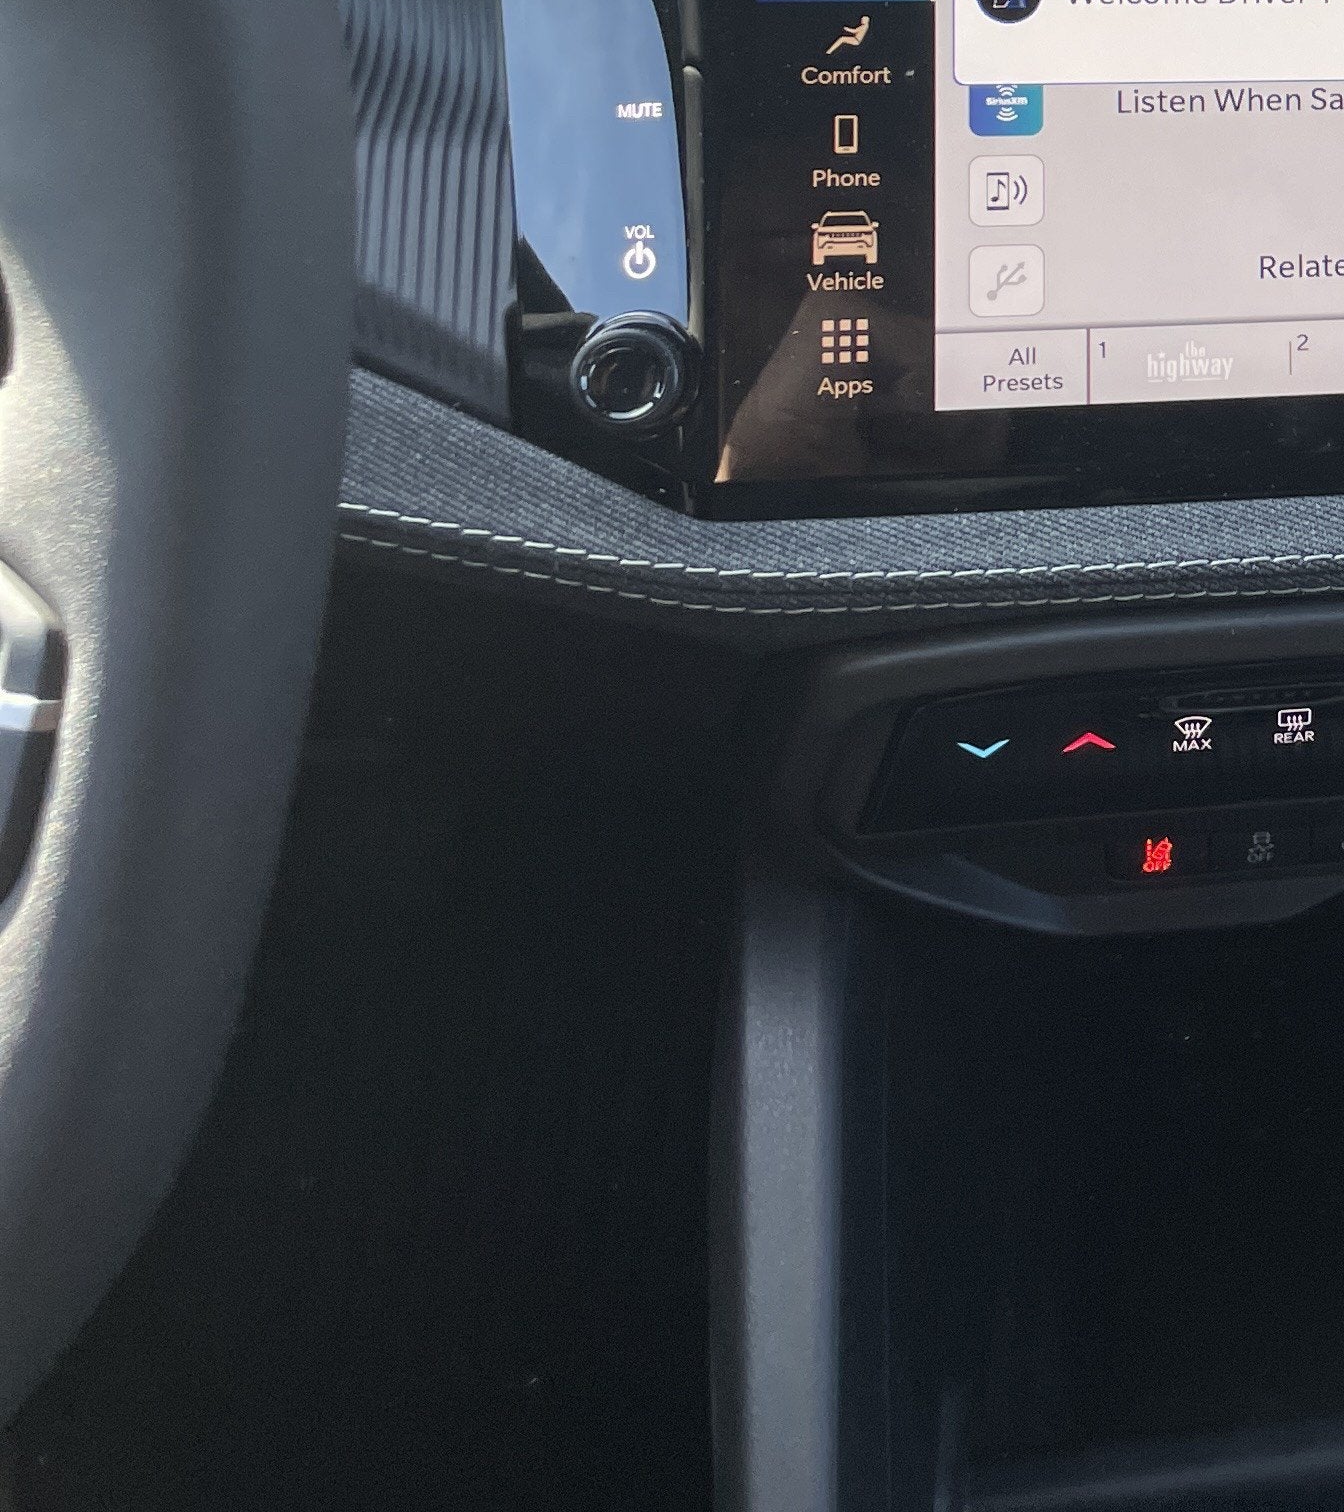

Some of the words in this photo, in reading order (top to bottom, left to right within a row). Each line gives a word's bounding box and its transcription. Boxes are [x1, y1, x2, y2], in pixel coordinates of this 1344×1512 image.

[801, 65, 891, 85] Comfort
[617, 102, 663, 118] MUTE
[1116, 88, 1206, 115] Listen
[1214, 87, 1302, 114] When
[812, 168, 881, 188] Phone
[625, 225, 655, 240] VOL
[807, 271, 884, 291] Vehicle
[1098, 341, 1107, 359] 1
[1185, 340, 1206, 357] the
[1296, 333, 1310, 352] 2
[1008, 346, 1037, 366] All
[1148, 352, 1234, 382] highway
[817, 376, 874, 398] Apps
[982, 371, 1064, 392] Presets
[1172, 737, 1212, 753] MAX
[1273, 729, 1315, 745] REAR
[1247, 850, 1275, 863] OFF
[1142, 860, 1172, 873] OFF
